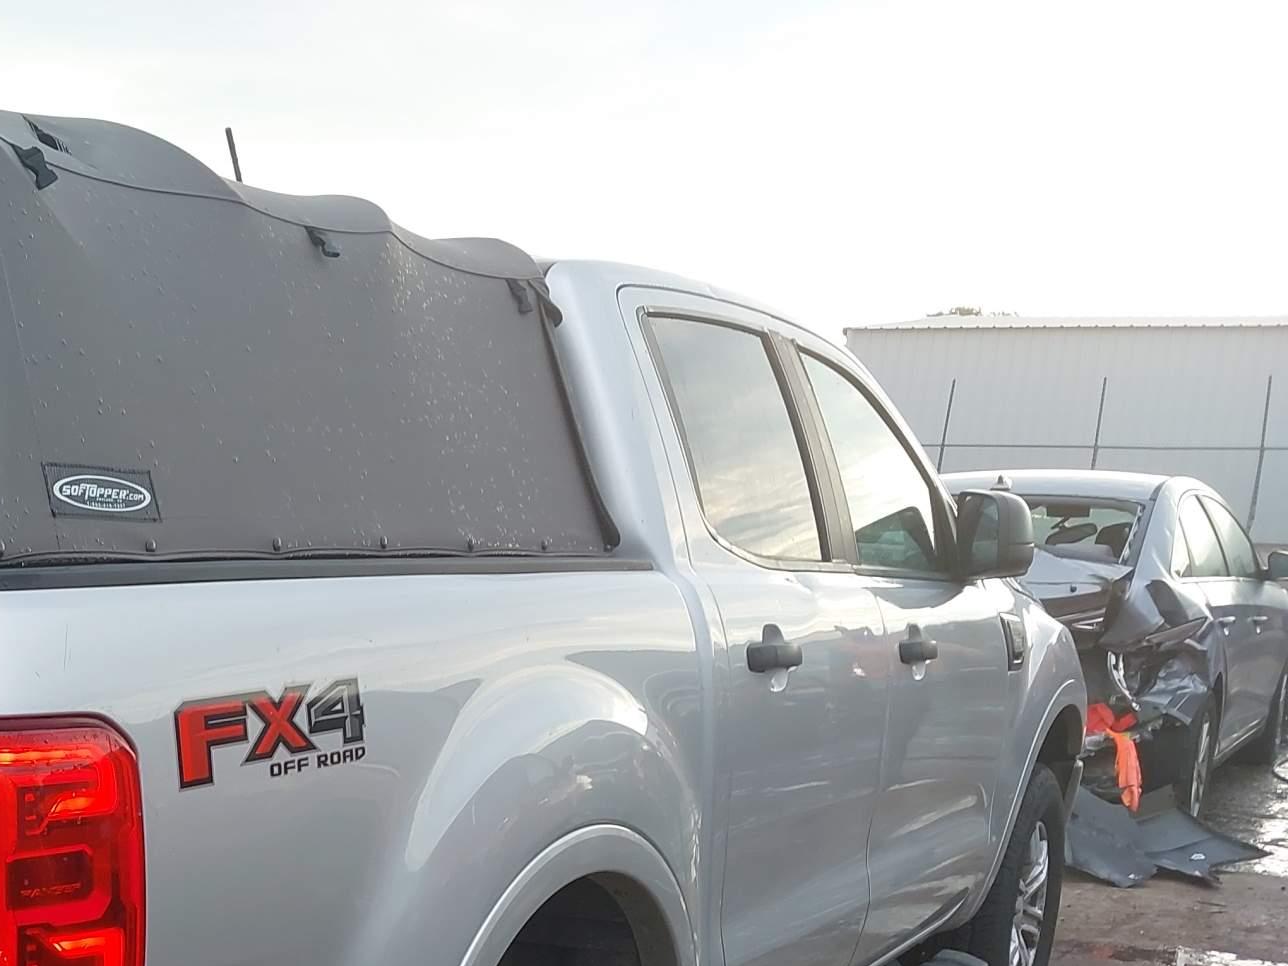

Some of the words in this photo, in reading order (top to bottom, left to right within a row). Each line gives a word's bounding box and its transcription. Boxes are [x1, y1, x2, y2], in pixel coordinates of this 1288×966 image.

[174, 677, 366, 790] FX4
[269, 757, 309, 777] OFF
[316, 746, 366, 769] ROAD
